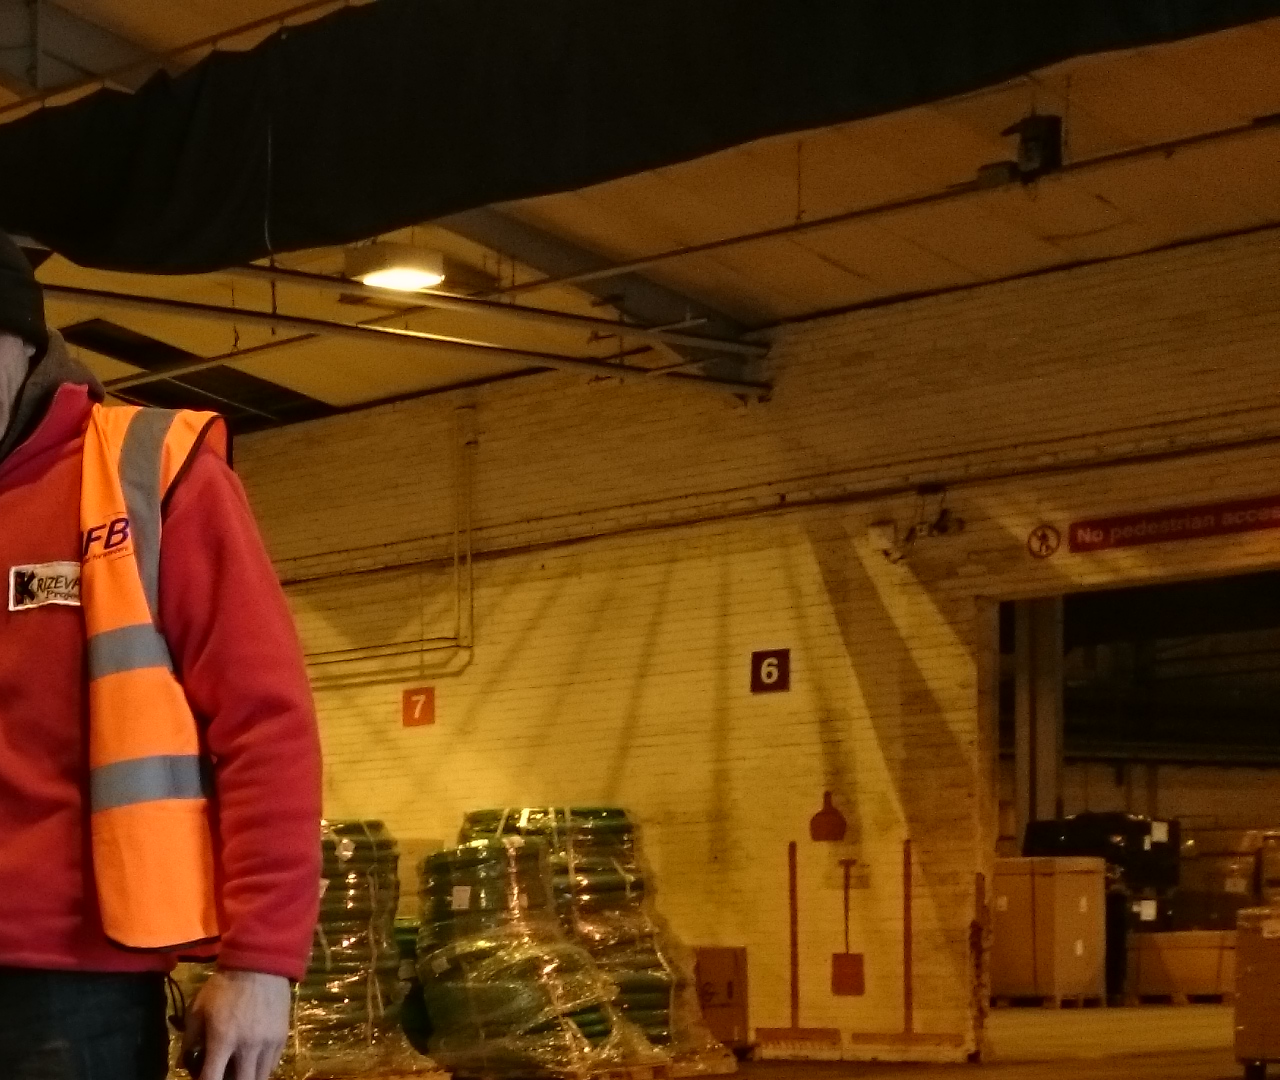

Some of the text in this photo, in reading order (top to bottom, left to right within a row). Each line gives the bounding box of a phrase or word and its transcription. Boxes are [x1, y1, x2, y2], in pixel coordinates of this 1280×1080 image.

[1076, 527, 1103, 542] No
[760, 658, 779, 684] 6
[410, 695, 426, 718] 7
